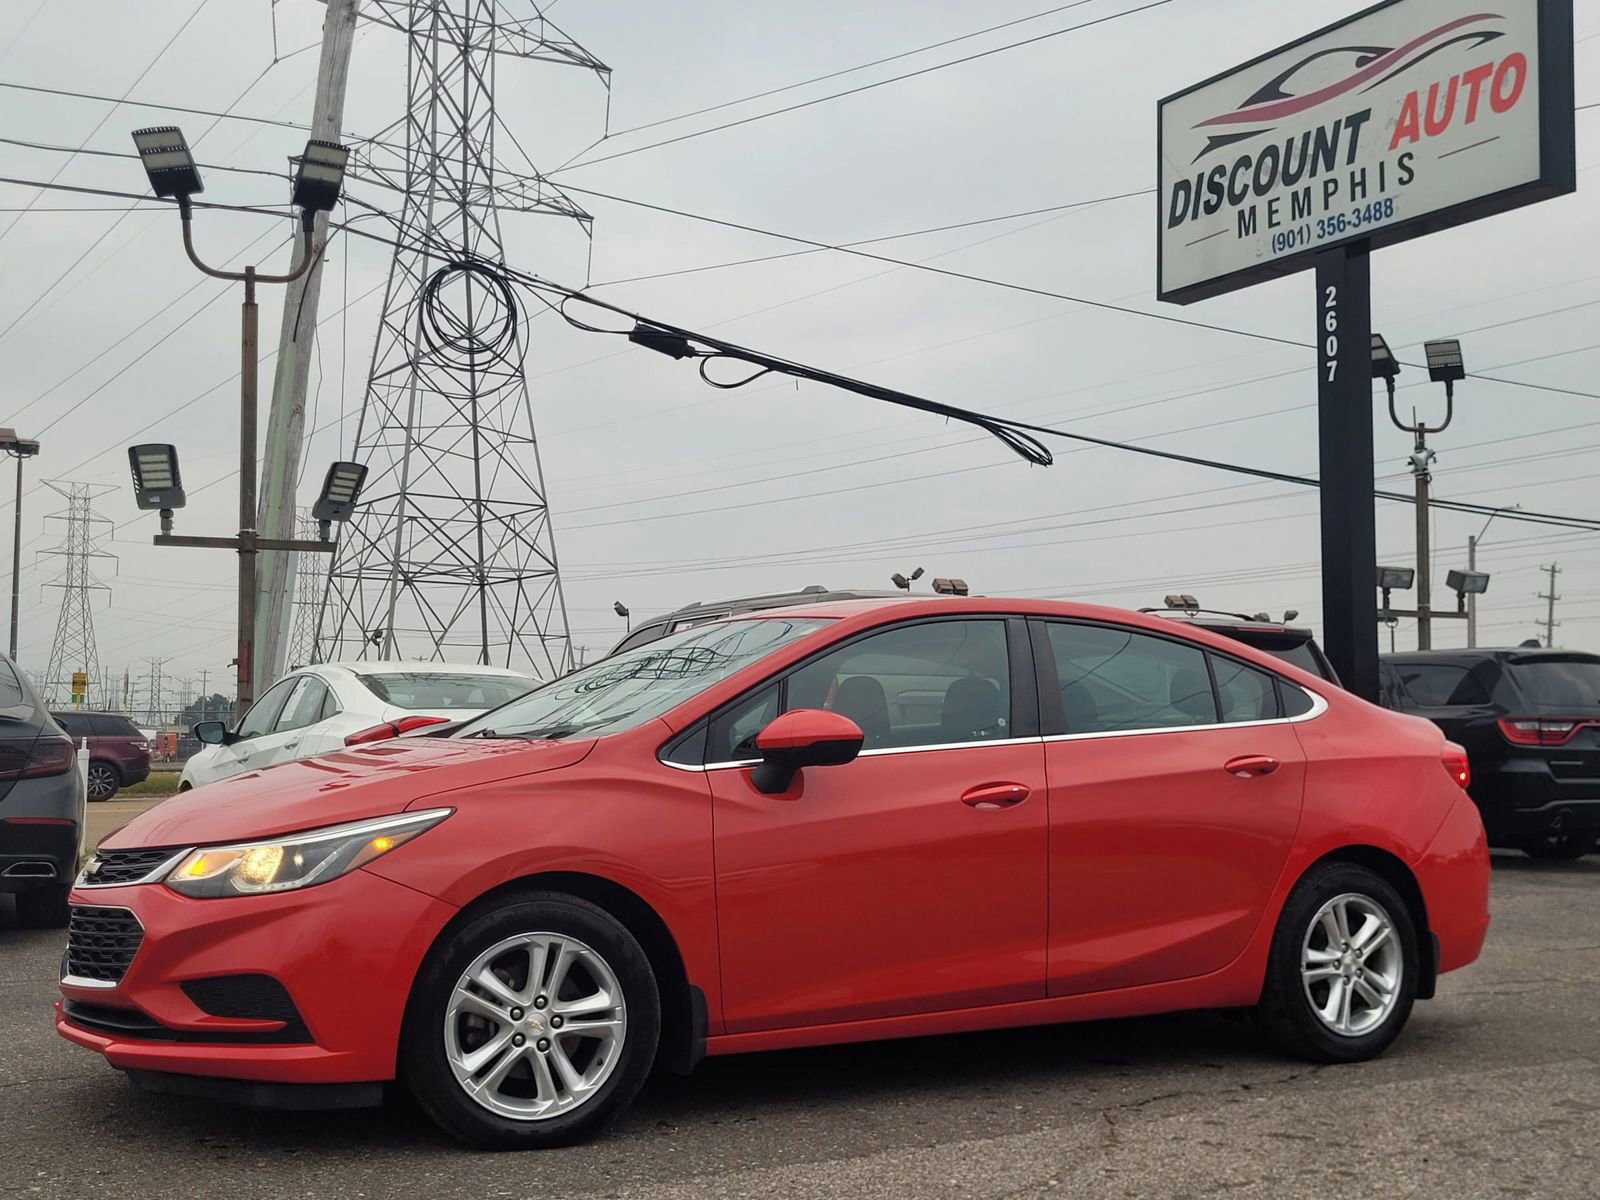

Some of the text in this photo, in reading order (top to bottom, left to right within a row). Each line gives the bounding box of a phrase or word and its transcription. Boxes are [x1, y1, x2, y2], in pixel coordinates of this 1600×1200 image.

[1168, 52, 1527, 229] DISCOUNT AUTO
[1237, 152, 1415, 239] MEMPHIS
[1272, 198, 1394, 254] (901) 356-3488
[1325, 285, 1338, 382] 2607
